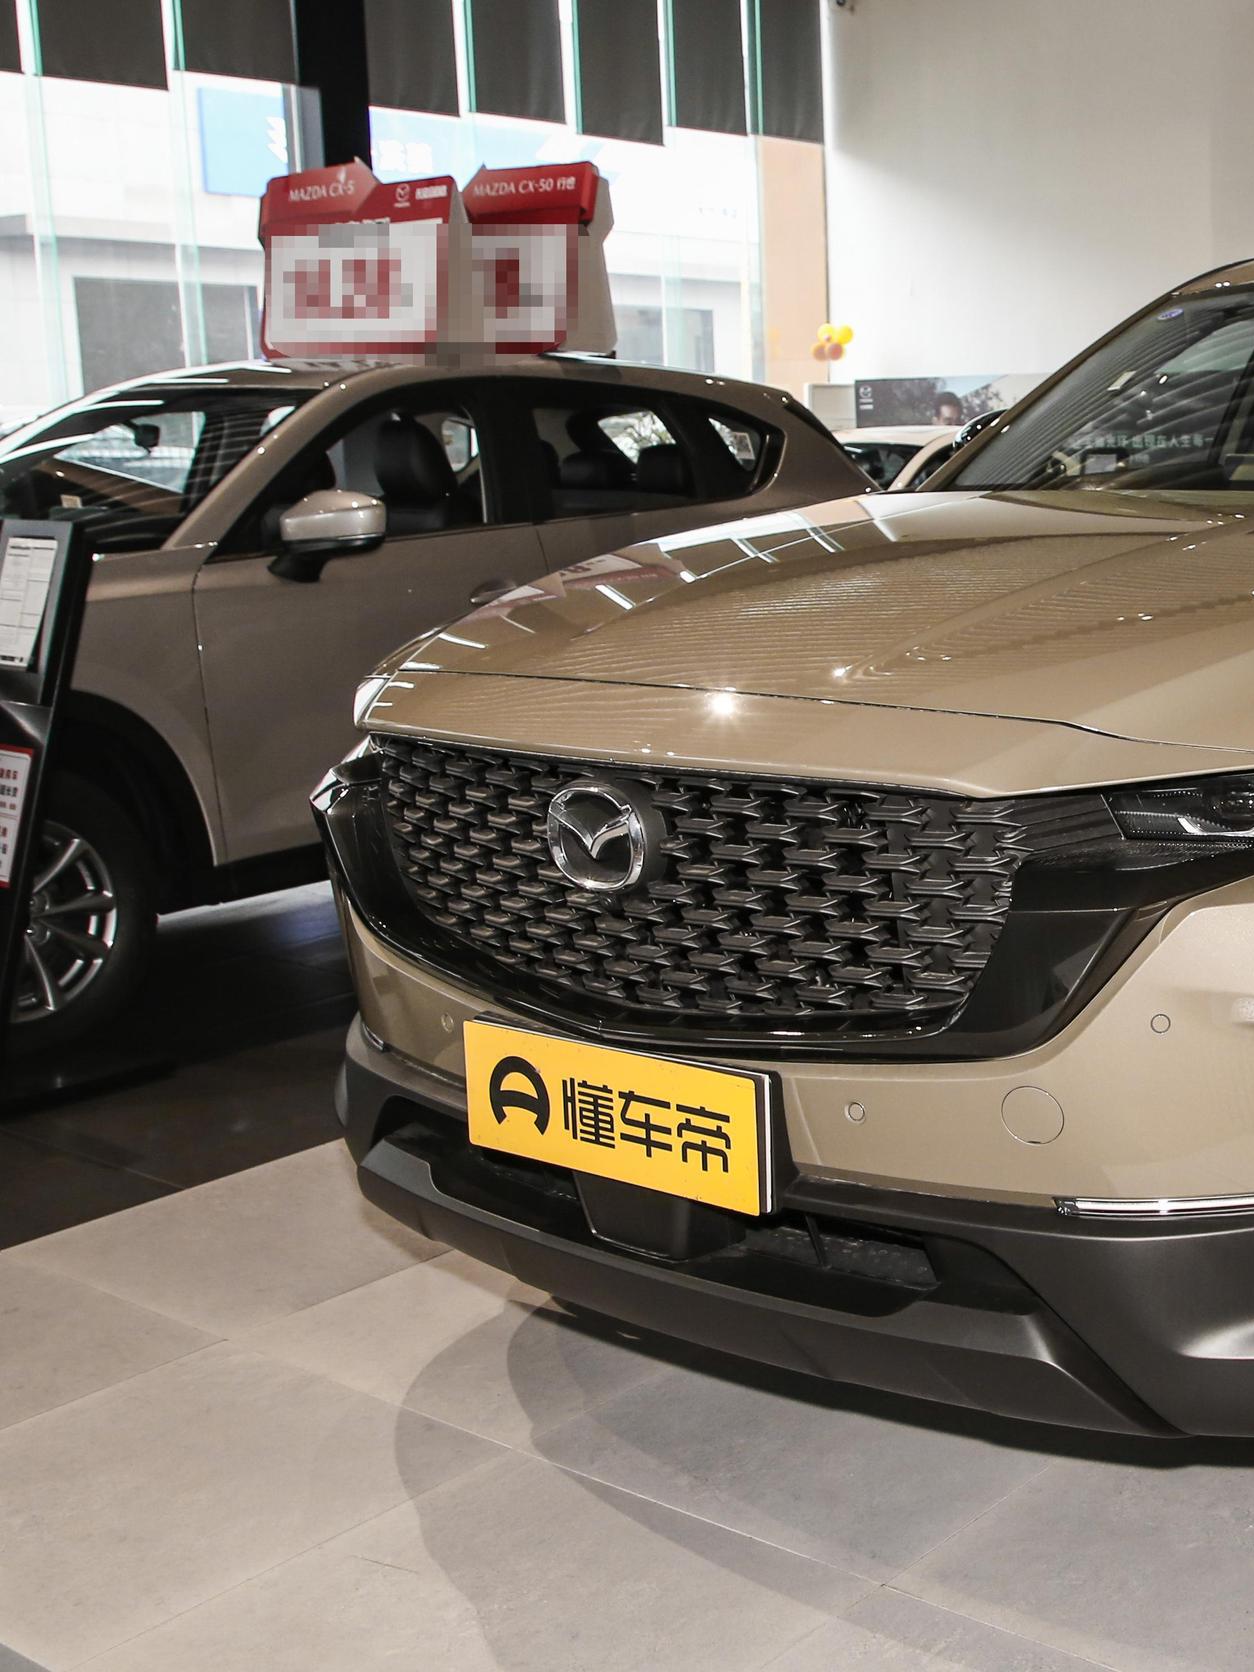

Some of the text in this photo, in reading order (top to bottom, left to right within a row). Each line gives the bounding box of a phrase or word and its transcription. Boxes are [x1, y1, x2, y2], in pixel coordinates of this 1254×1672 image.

[289, 180, 355, 201] MAZDA CX-5
[474, 181, 515, 196] MAZDA
[518, 178, 554, 194] CX-50
[562, 1077, 731, 1173] 懂车帝
